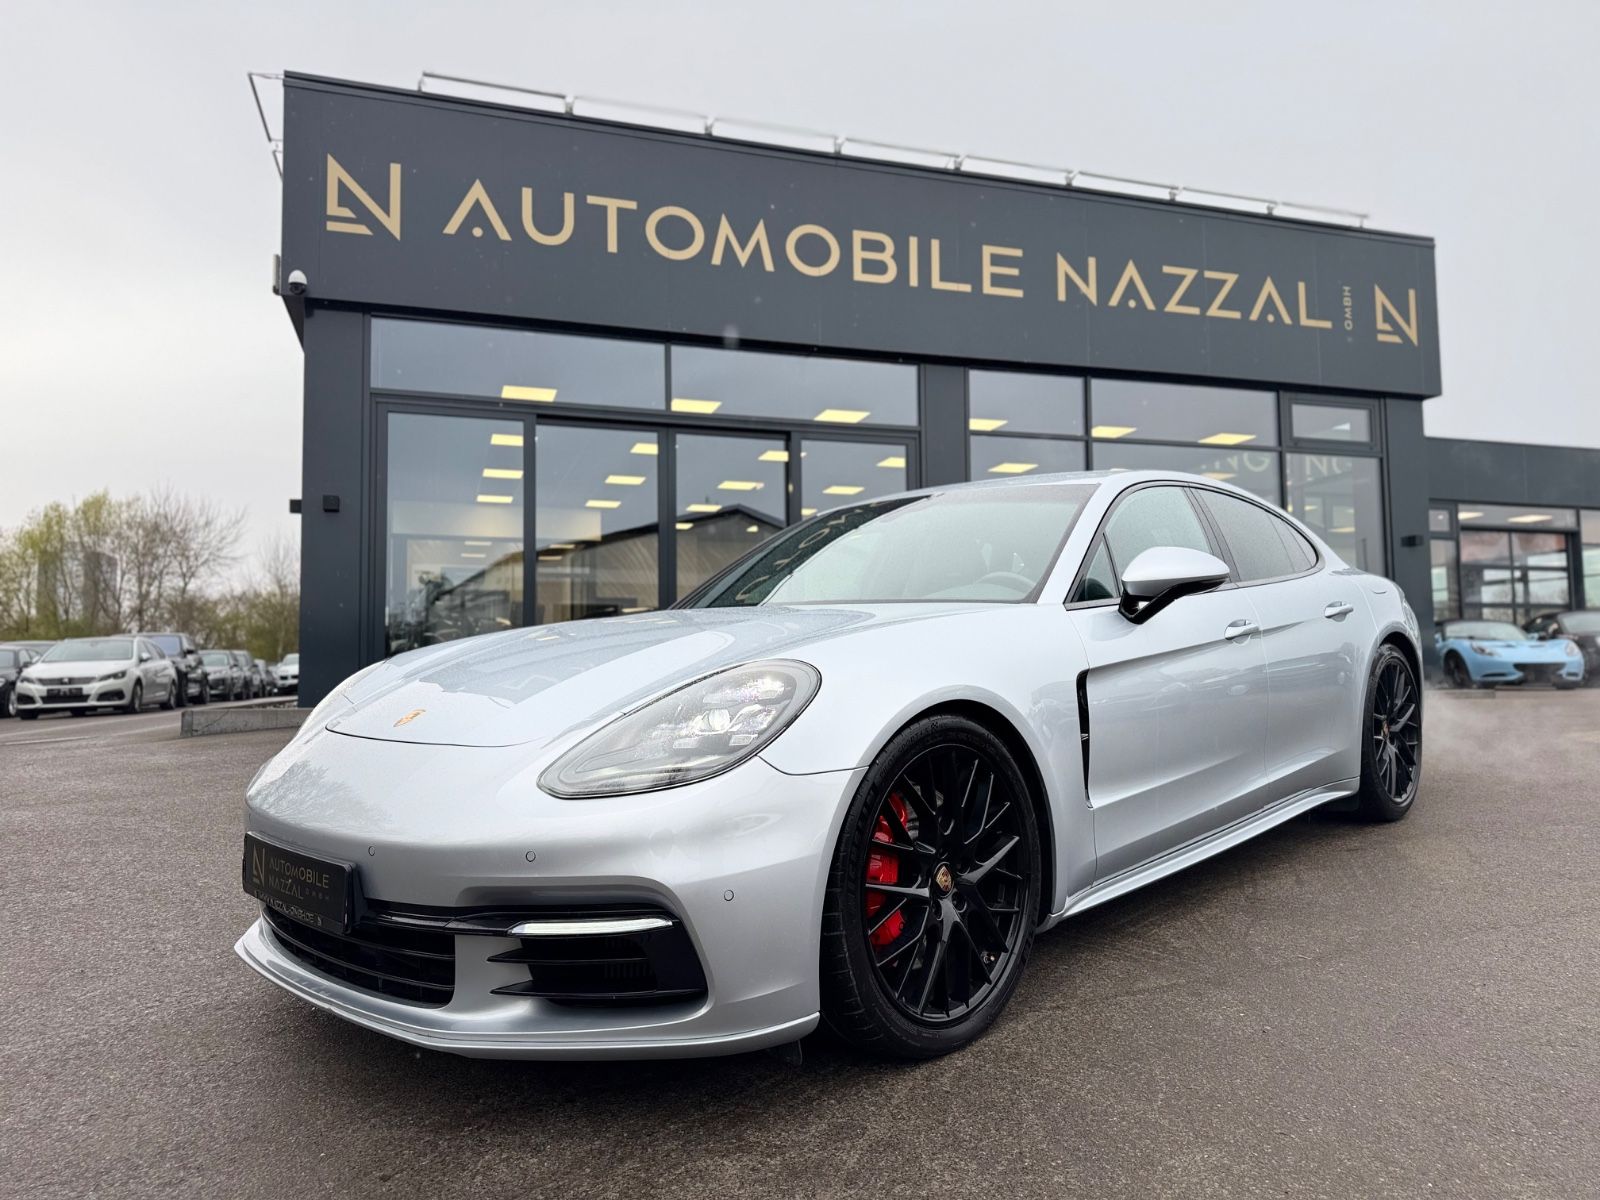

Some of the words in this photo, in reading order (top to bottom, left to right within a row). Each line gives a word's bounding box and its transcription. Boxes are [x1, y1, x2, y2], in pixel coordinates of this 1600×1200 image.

[444, 181, 1024, 297] AUTOMOBILE
[1056, 253, 1332, 329] NAZZAL
[269, 857, 330, 887] AUTOMOBILE
